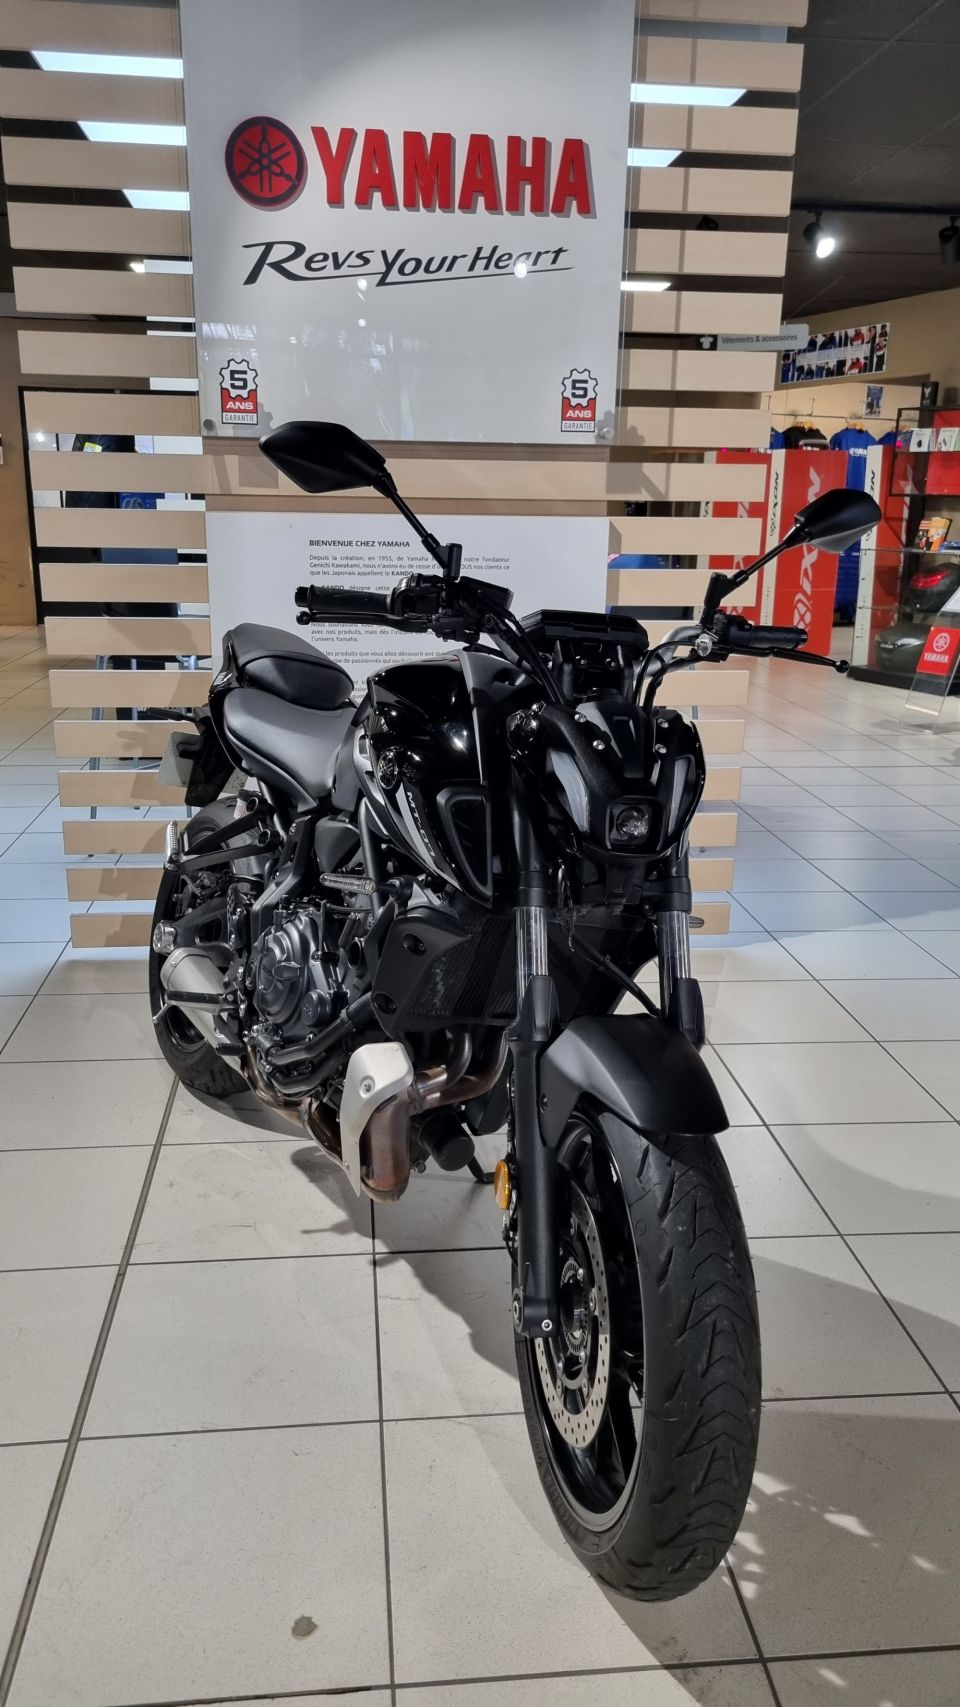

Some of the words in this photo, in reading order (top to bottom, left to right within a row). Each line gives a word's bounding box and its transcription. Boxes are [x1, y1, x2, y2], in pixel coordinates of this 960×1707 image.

[310, 126, 595, 216] YAMAHA
[241, 240, 378, 286] Revs
[376, 248, 468, 287] Your
[467, 244, 569, 273] Heart
[721, 335, 754, 345] Vêtements
[755, 335, 761, 343] &
[230, 369, 248, 390] 5
[571, 379, 589, 398] 5
[226, 401, 254, 410] ANS
[224, 414, 255, 423] GARANTIE
[566, 410, 592, 418] ANS
[563, 422, 593, 430] GARANTIE
[309, 539, 354, 547] BIENVENUE
[355, 540, 376, 548] CHEZ
[377, 540, 410, 548] YAMAHA
[309, 554, 330, 562] Depuis
[340, 554, 365, 562] création,
[334, 650, 358, 658] produits
[923, 652, 949, 664] YAMAHA
[406, 791, 436, 857] MT-07
